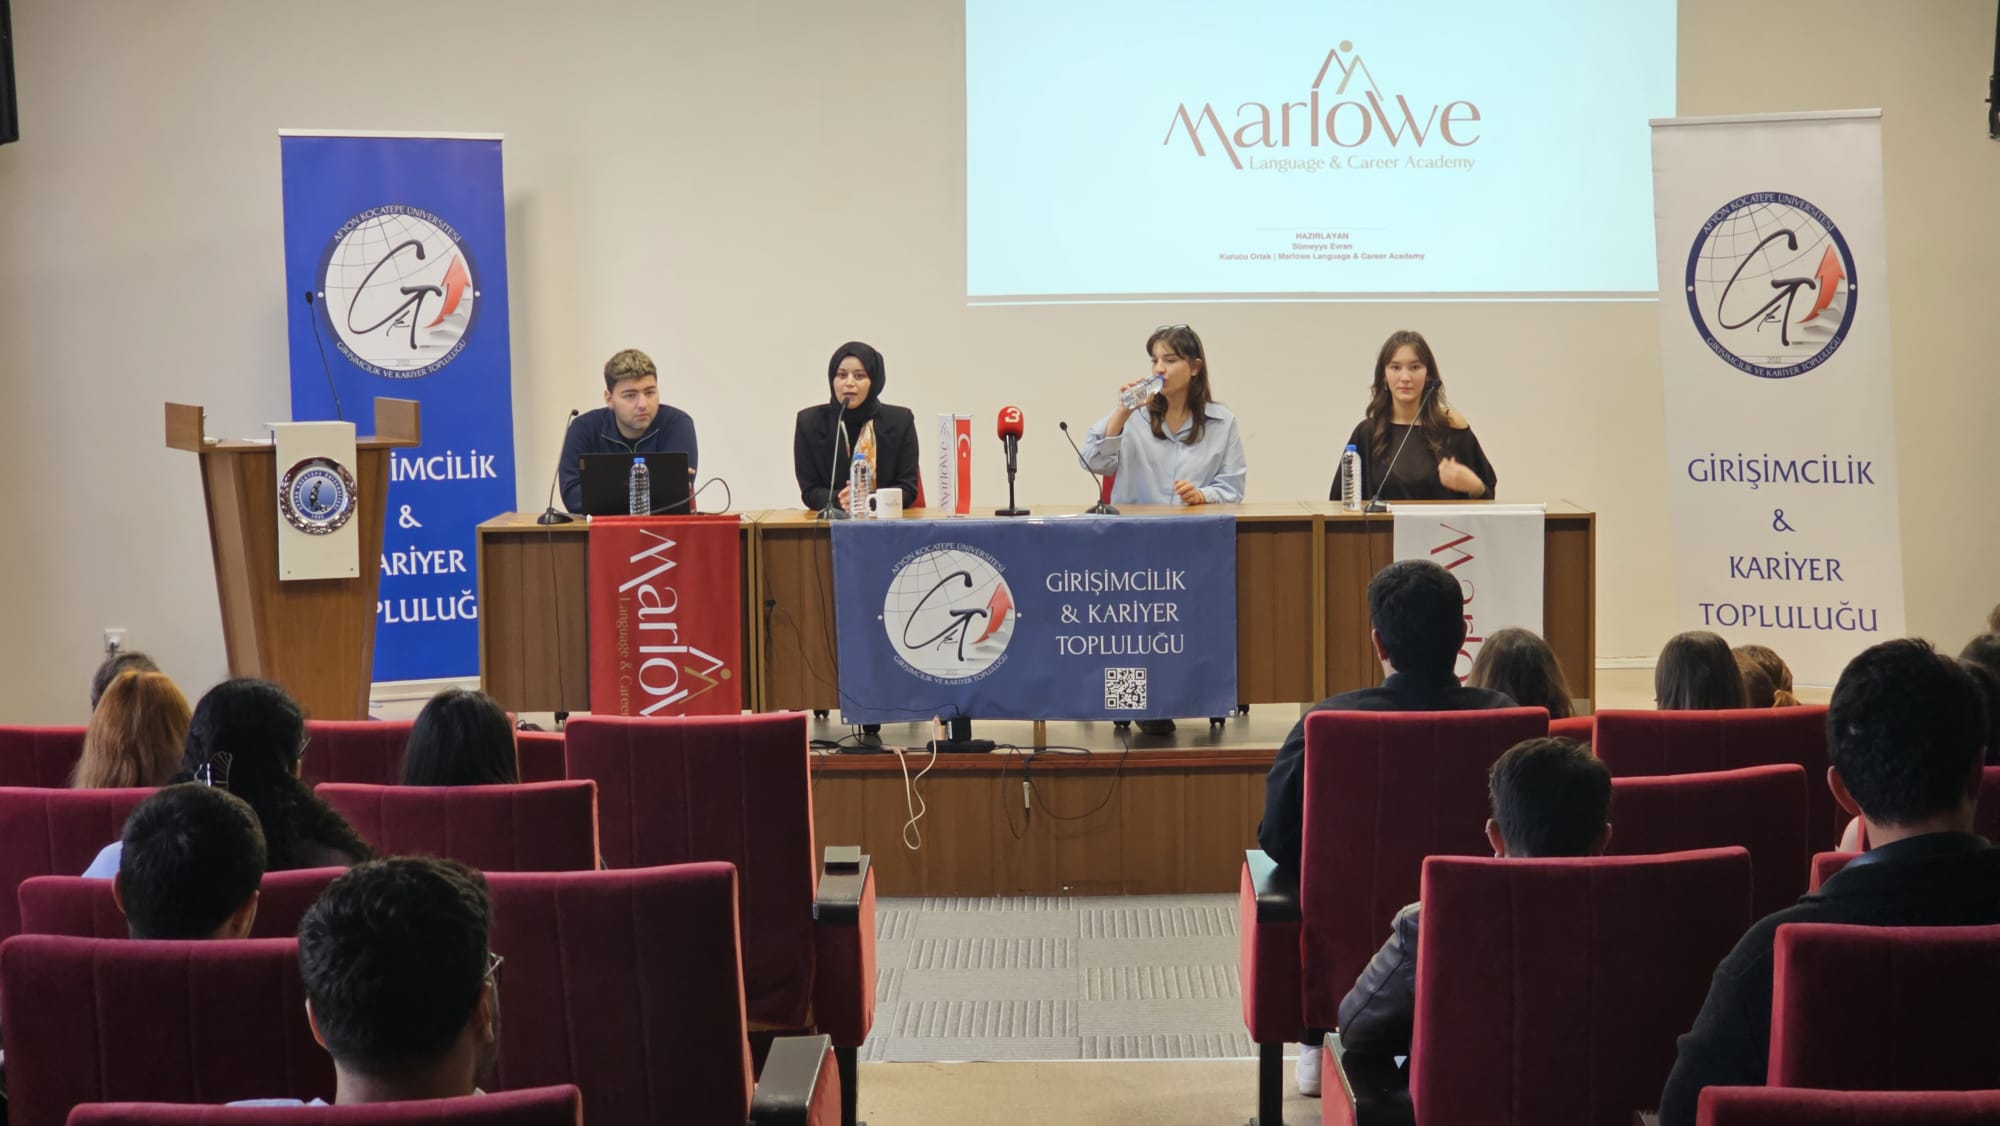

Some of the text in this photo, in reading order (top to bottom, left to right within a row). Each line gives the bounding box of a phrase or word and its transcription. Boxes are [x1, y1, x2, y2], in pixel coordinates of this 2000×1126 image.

[1163, 89, 1481, 170] Marlowe
[1249, 154, 1475, 172] Language & Career Academy
[334, 215, 360, 242] AFYON
[360, 205, 405, 221] KOCATEPE
[1703, 206, 1732, 235] AFYON
[1730, 193, 1776, 211] KOCATEPE
[1312, 252, 1351, 262] Language
[1388, 252, 1425, 262] Academy
[1004, 407, 1020, 423] 3
[391, 449, 497, 481] İMCİLİK
[1687, 452, 1875, 490] GİRİŞİMCİLİK
[399, 504, 423, 528] &
[1772, 508, 1796, 532] &
[380, 545, 467, 576] ARİYER
[891, 553, 915, 576] AFYON
[915, 542, 956, 557] KOCATEPE
[1729, 551, 1844, 582] KARİYER
[1046, 568, 1186, 596] GİRİŞİMCİLİK
[1061, 600, 1180, 624] & KARİYER
[1698, 600, 1879, 632] TOPLULUĞU
[1055, 631, 1184, 656] TOPLULUĞU
[620, 661, 632, 671] &
